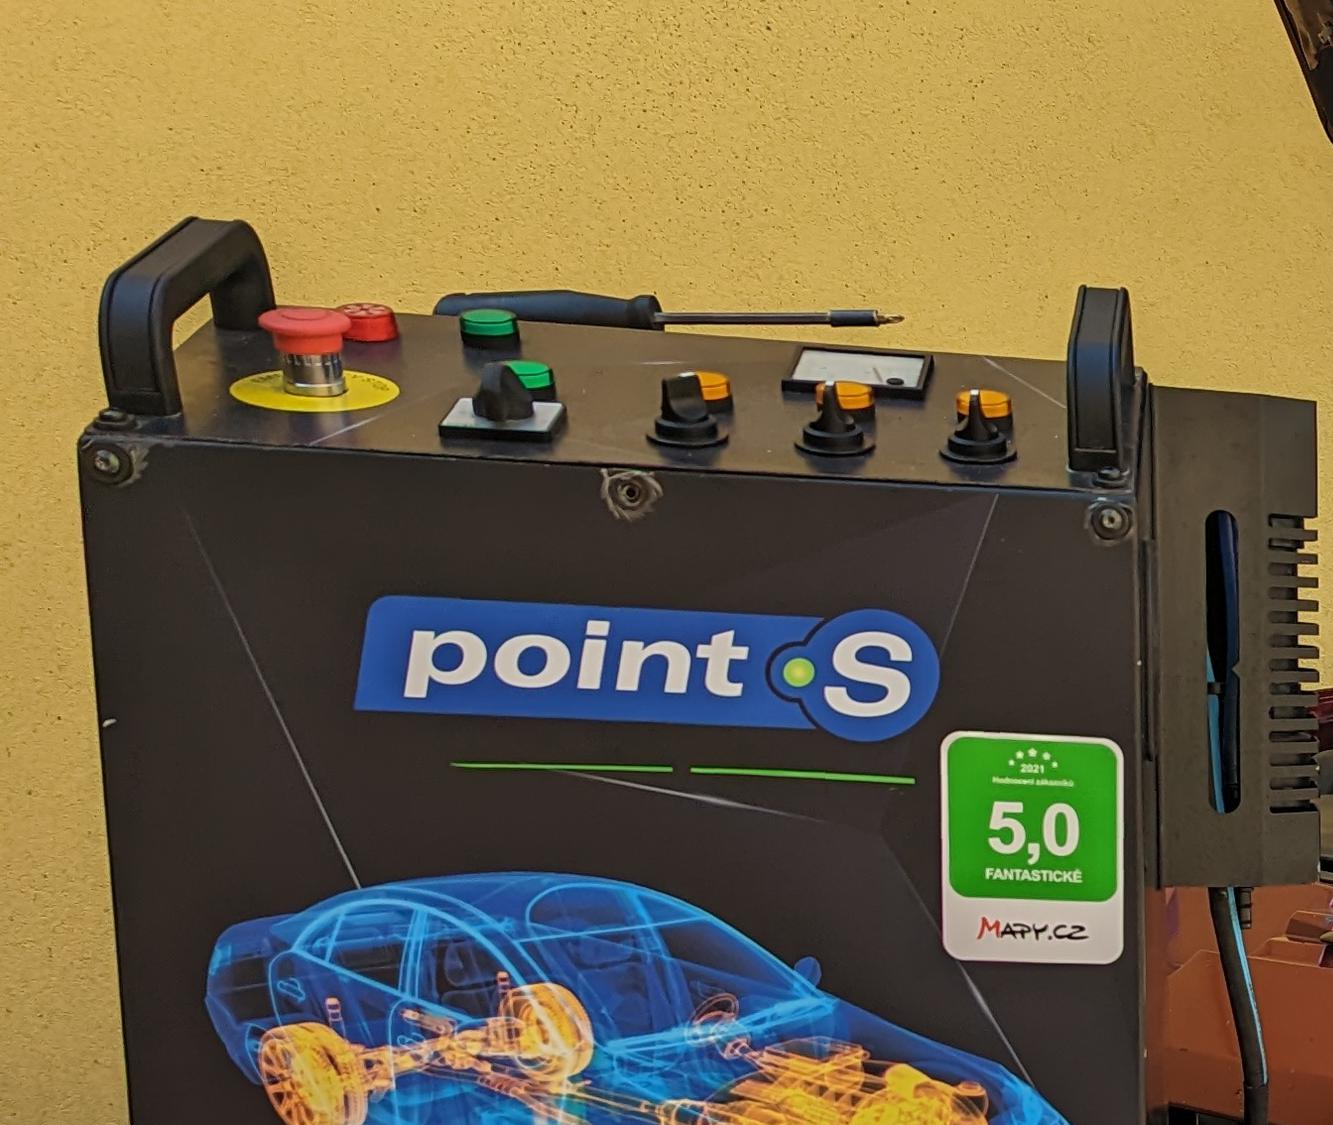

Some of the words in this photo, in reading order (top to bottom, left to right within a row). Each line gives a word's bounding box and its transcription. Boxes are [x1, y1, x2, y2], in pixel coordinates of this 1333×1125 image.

[403, 619, 750, 698] point
[823, 630, 914, 718] S
[1020, 763, 1045, 774] 2021
[987, 801, 1080, 865] 5,0
[984, 867, 1083, 884] FANTASTICKÉ
